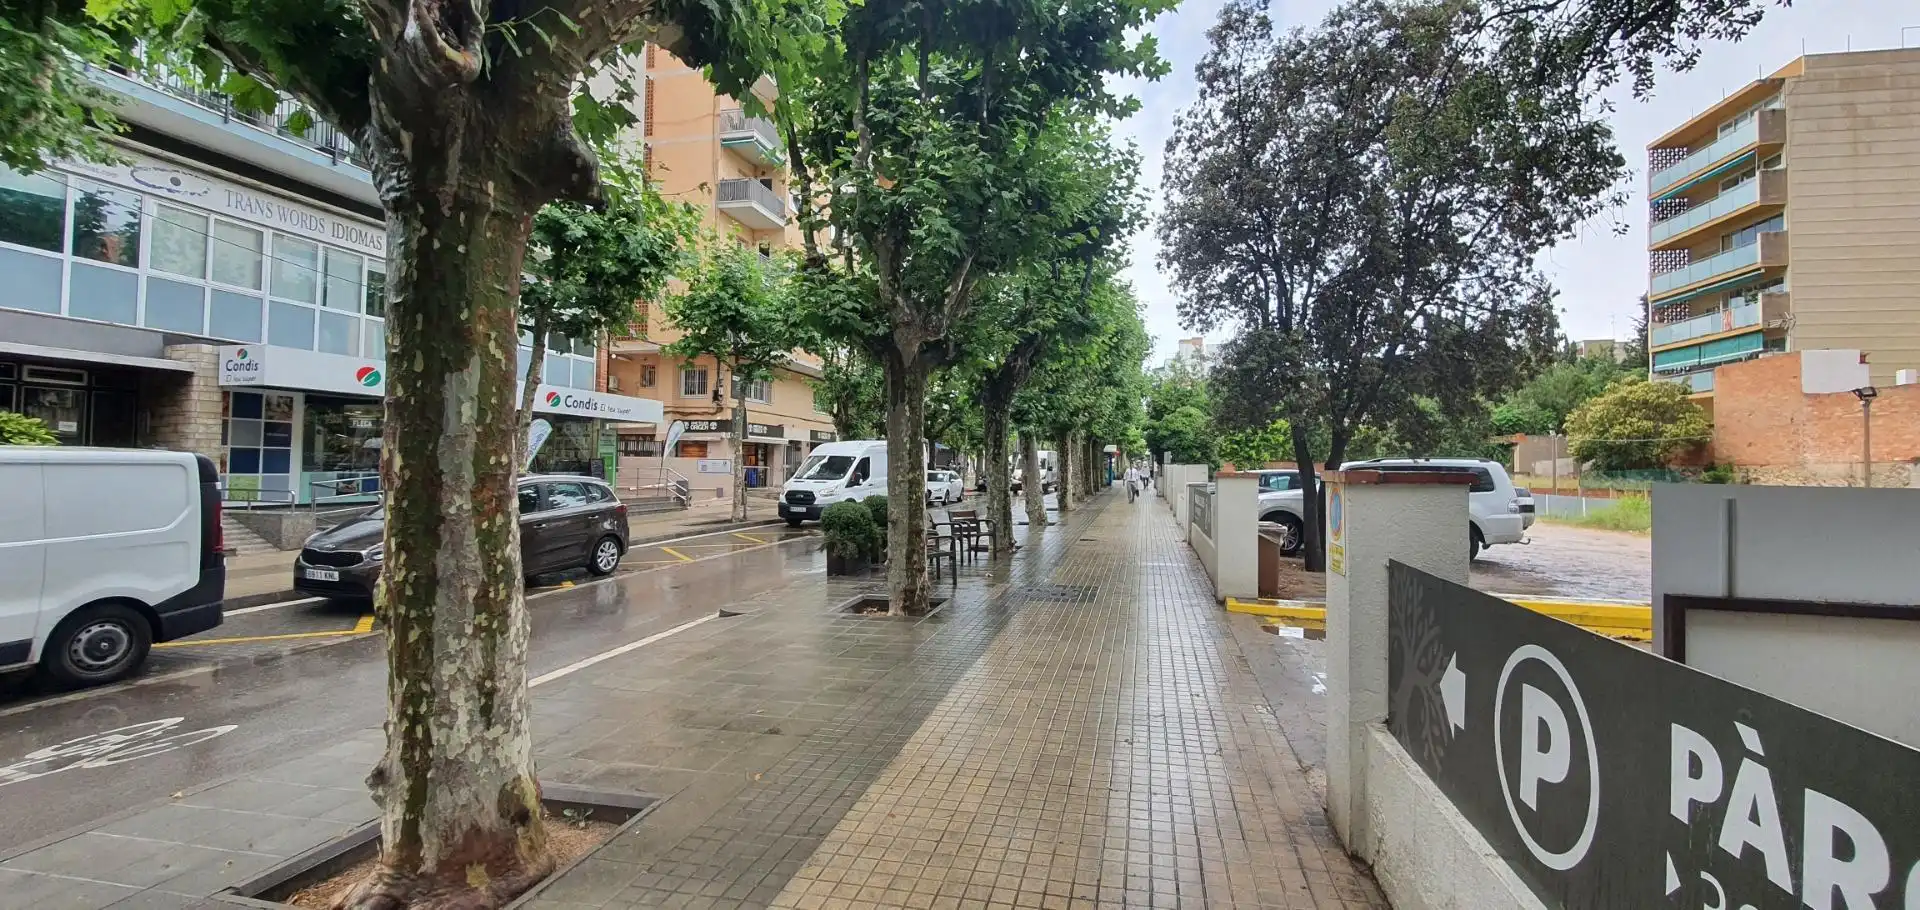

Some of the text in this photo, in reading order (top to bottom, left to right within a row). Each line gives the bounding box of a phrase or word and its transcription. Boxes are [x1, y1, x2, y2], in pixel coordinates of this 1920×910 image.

[224, 188, 383, 250] TRANS WORDS IDIOMAS
[225, 358, 259, 371] Condis
[564, 394, 598, 411] Condis
[1520, 683, 1571, 812] P
